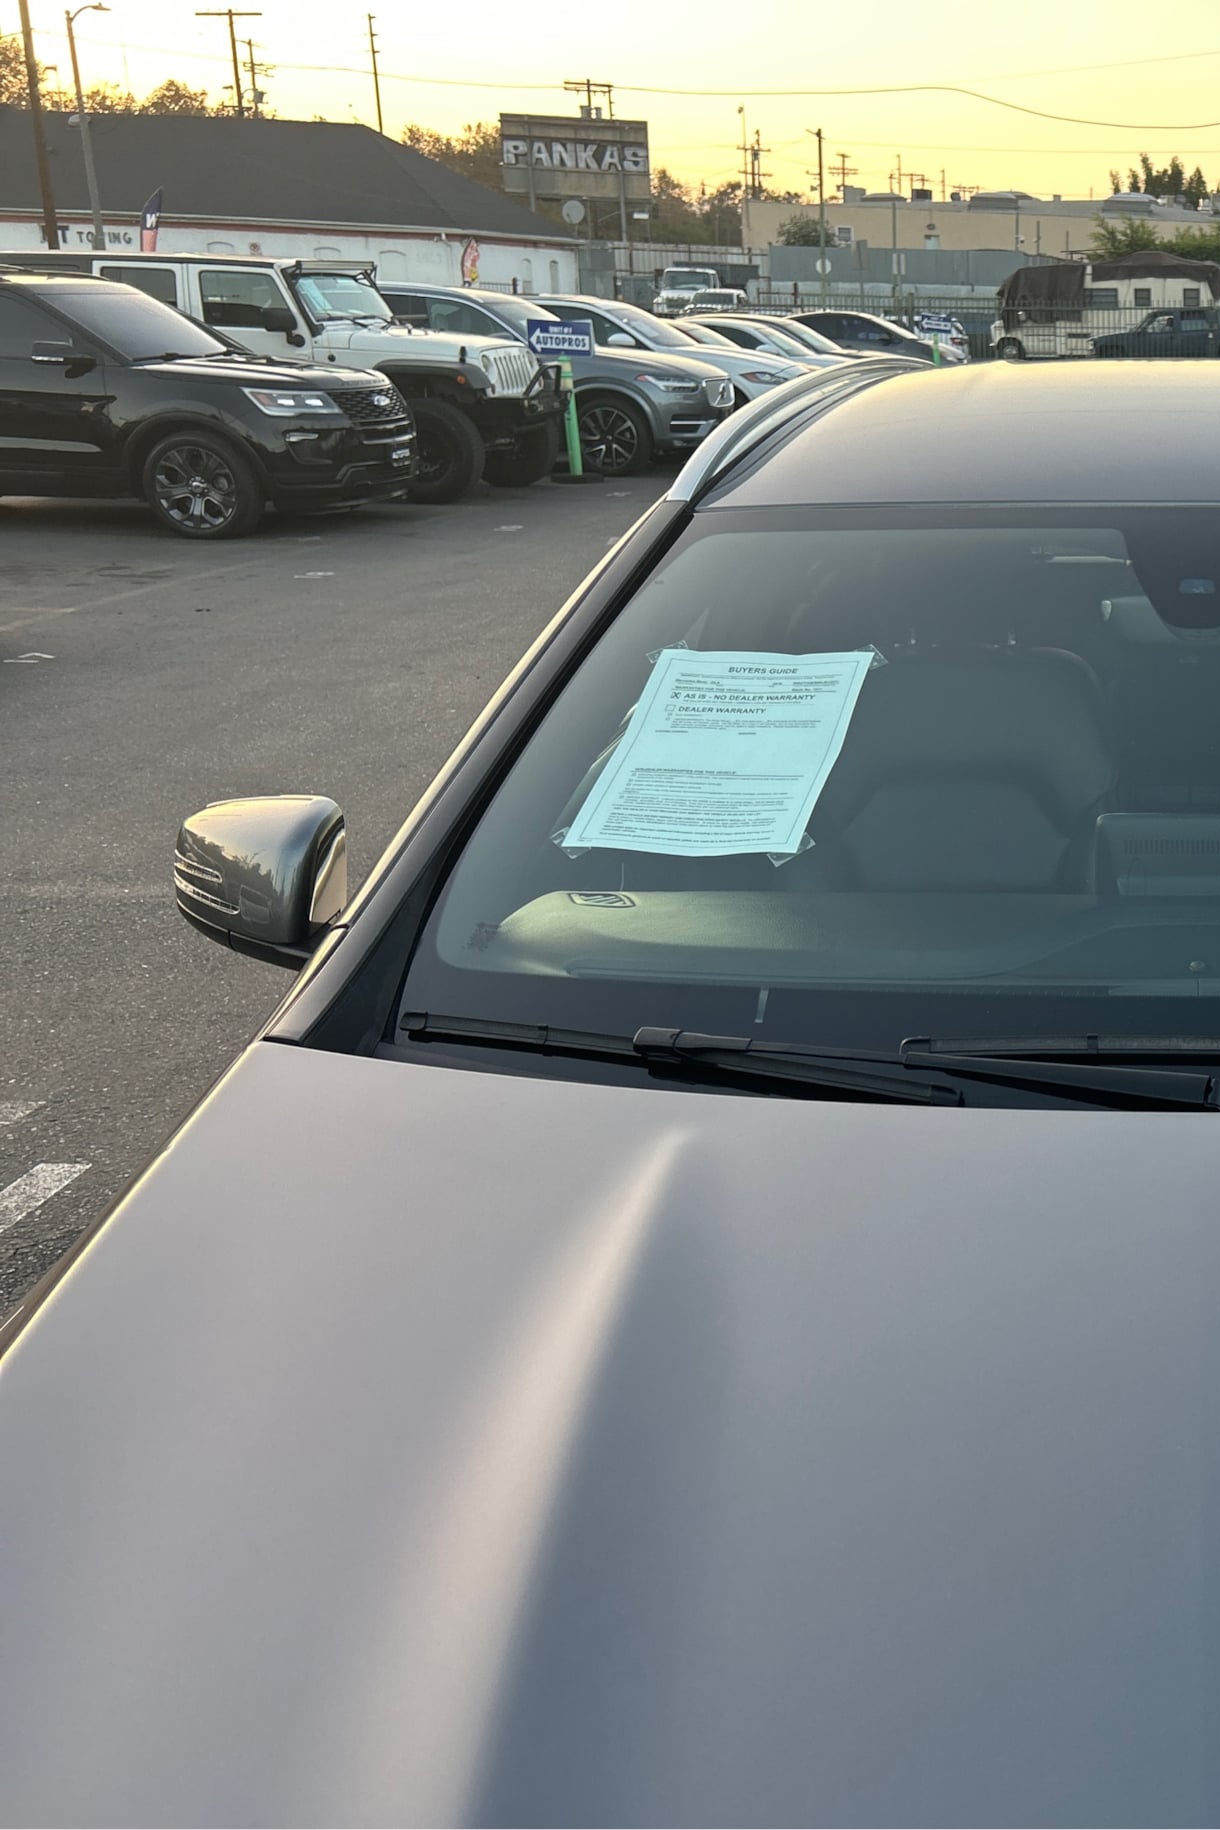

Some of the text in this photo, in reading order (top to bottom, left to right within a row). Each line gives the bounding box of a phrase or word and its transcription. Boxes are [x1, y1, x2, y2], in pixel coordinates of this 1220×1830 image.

[502, 139, 648, 172] PANKAS
[76, 230, 133, 245] TOING
[536, 335, 587, 348] AUTOPROS
[728, 667, 767, 675] BUYERS
